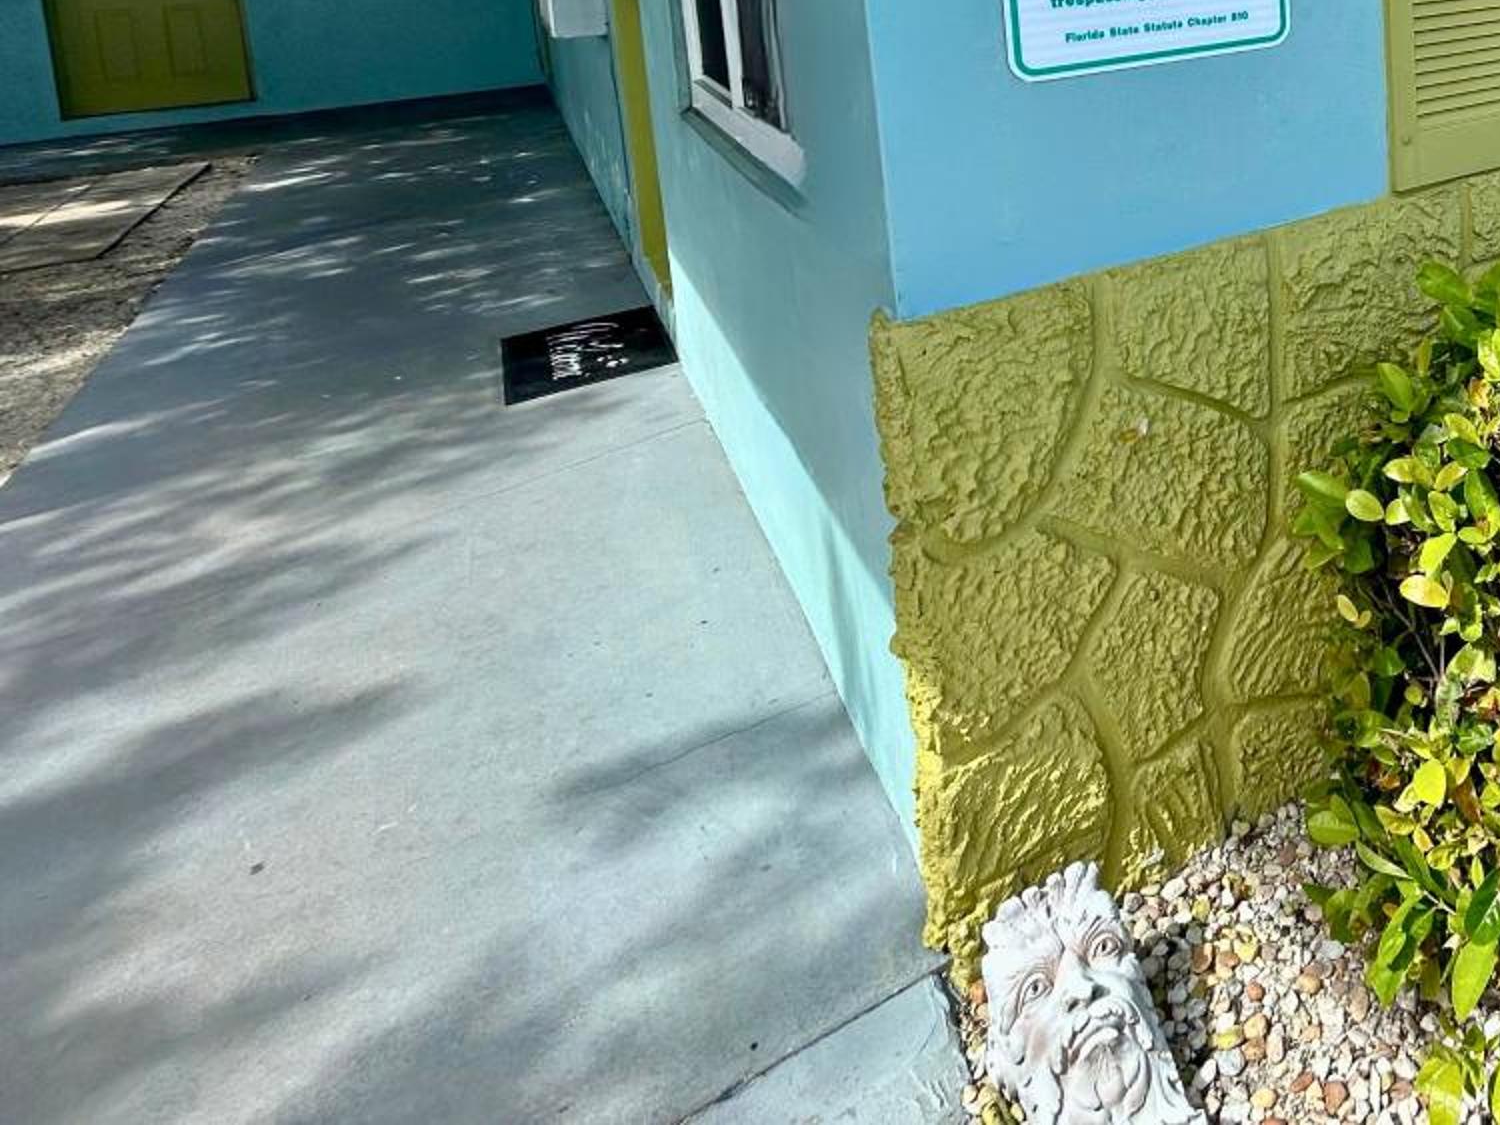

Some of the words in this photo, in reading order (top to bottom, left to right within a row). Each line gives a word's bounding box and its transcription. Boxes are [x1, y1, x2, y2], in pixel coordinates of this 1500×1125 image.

[1065, 29, 1105, 43] Florida
[1109, 25, 1139, 37] State
[1143, 20, 1183, 33] Statute
[1187, 15, 1227, 27] Chapter
